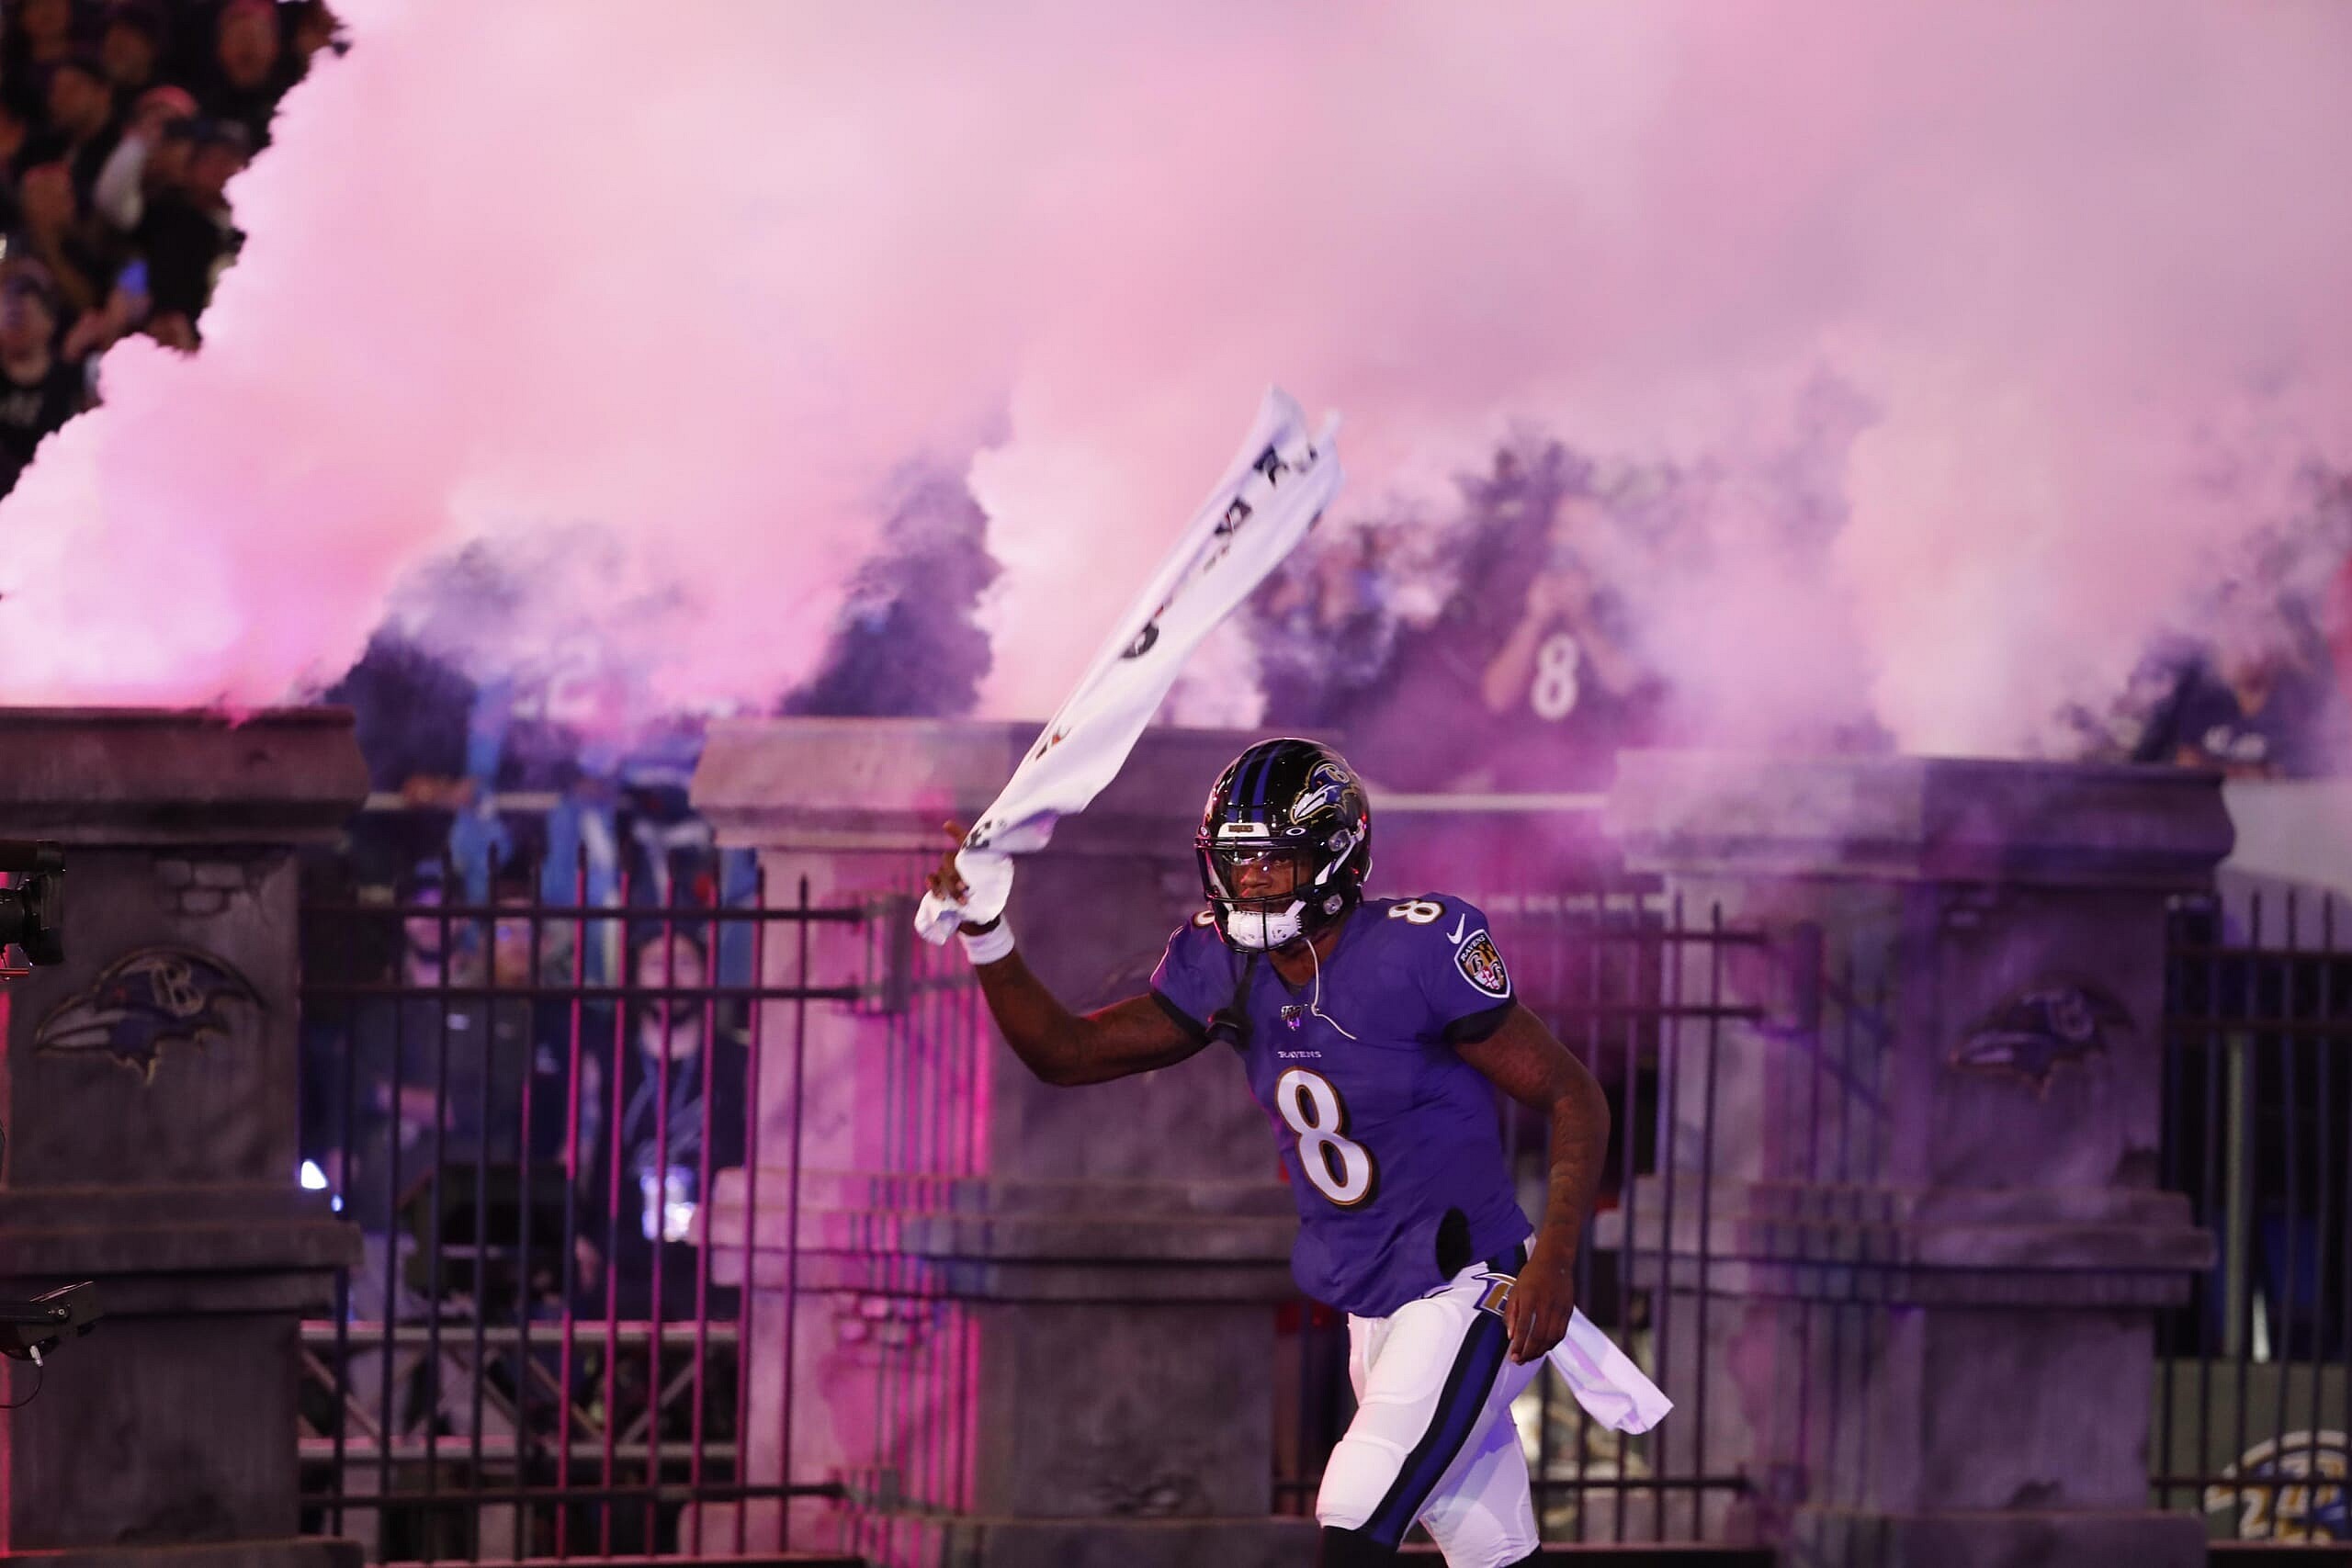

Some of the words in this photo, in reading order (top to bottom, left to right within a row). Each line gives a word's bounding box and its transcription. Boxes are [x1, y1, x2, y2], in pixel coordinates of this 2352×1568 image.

[1530, 634, 1580, 720] 8
[1387, 899, 1443, 925] 8
[1460, 935, 1486, 962] RAVENS
[1275, 1066, 1374, 1205] 8
